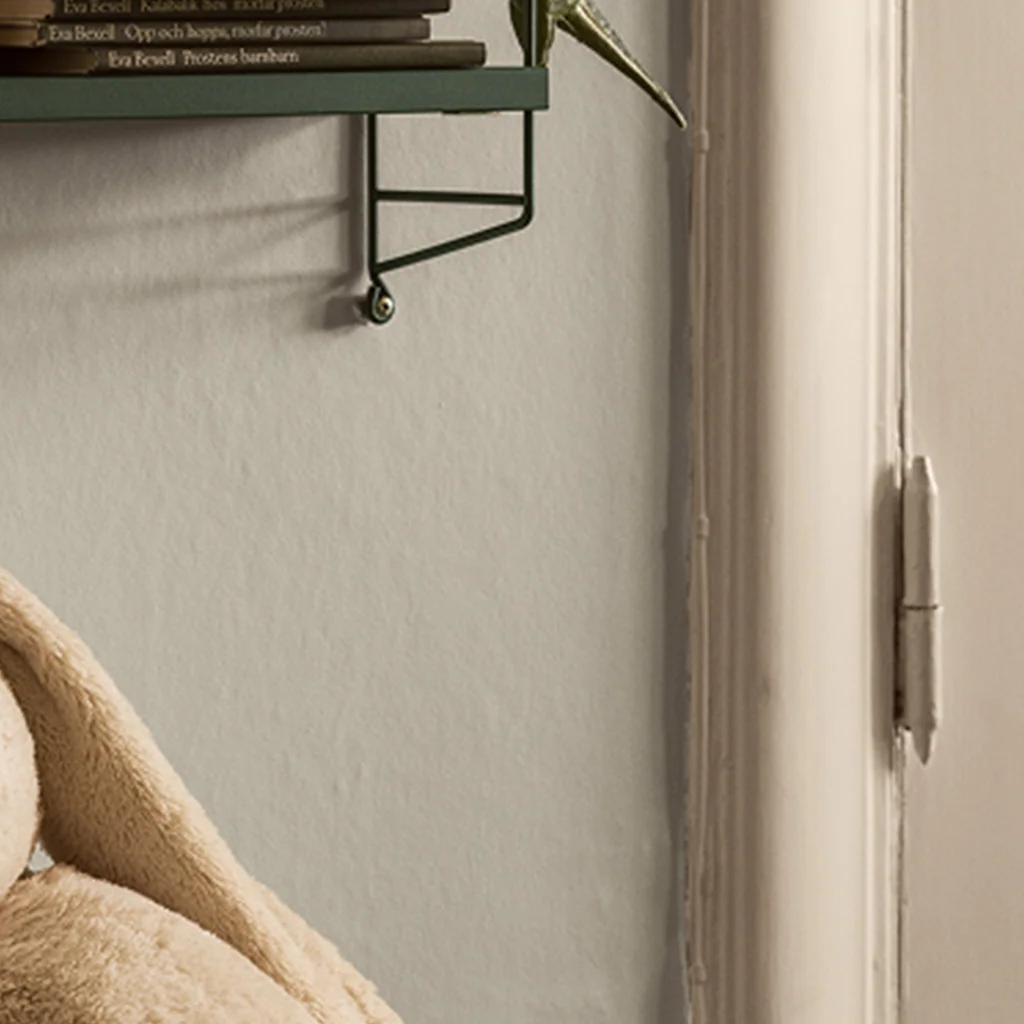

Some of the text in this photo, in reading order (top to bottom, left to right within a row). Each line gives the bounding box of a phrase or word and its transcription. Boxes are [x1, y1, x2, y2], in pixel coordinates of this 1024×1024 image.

[49, 25, 73, 41] Eva
[158, 23, 184, 39] och
[108, 51, 133, 68] Eva
